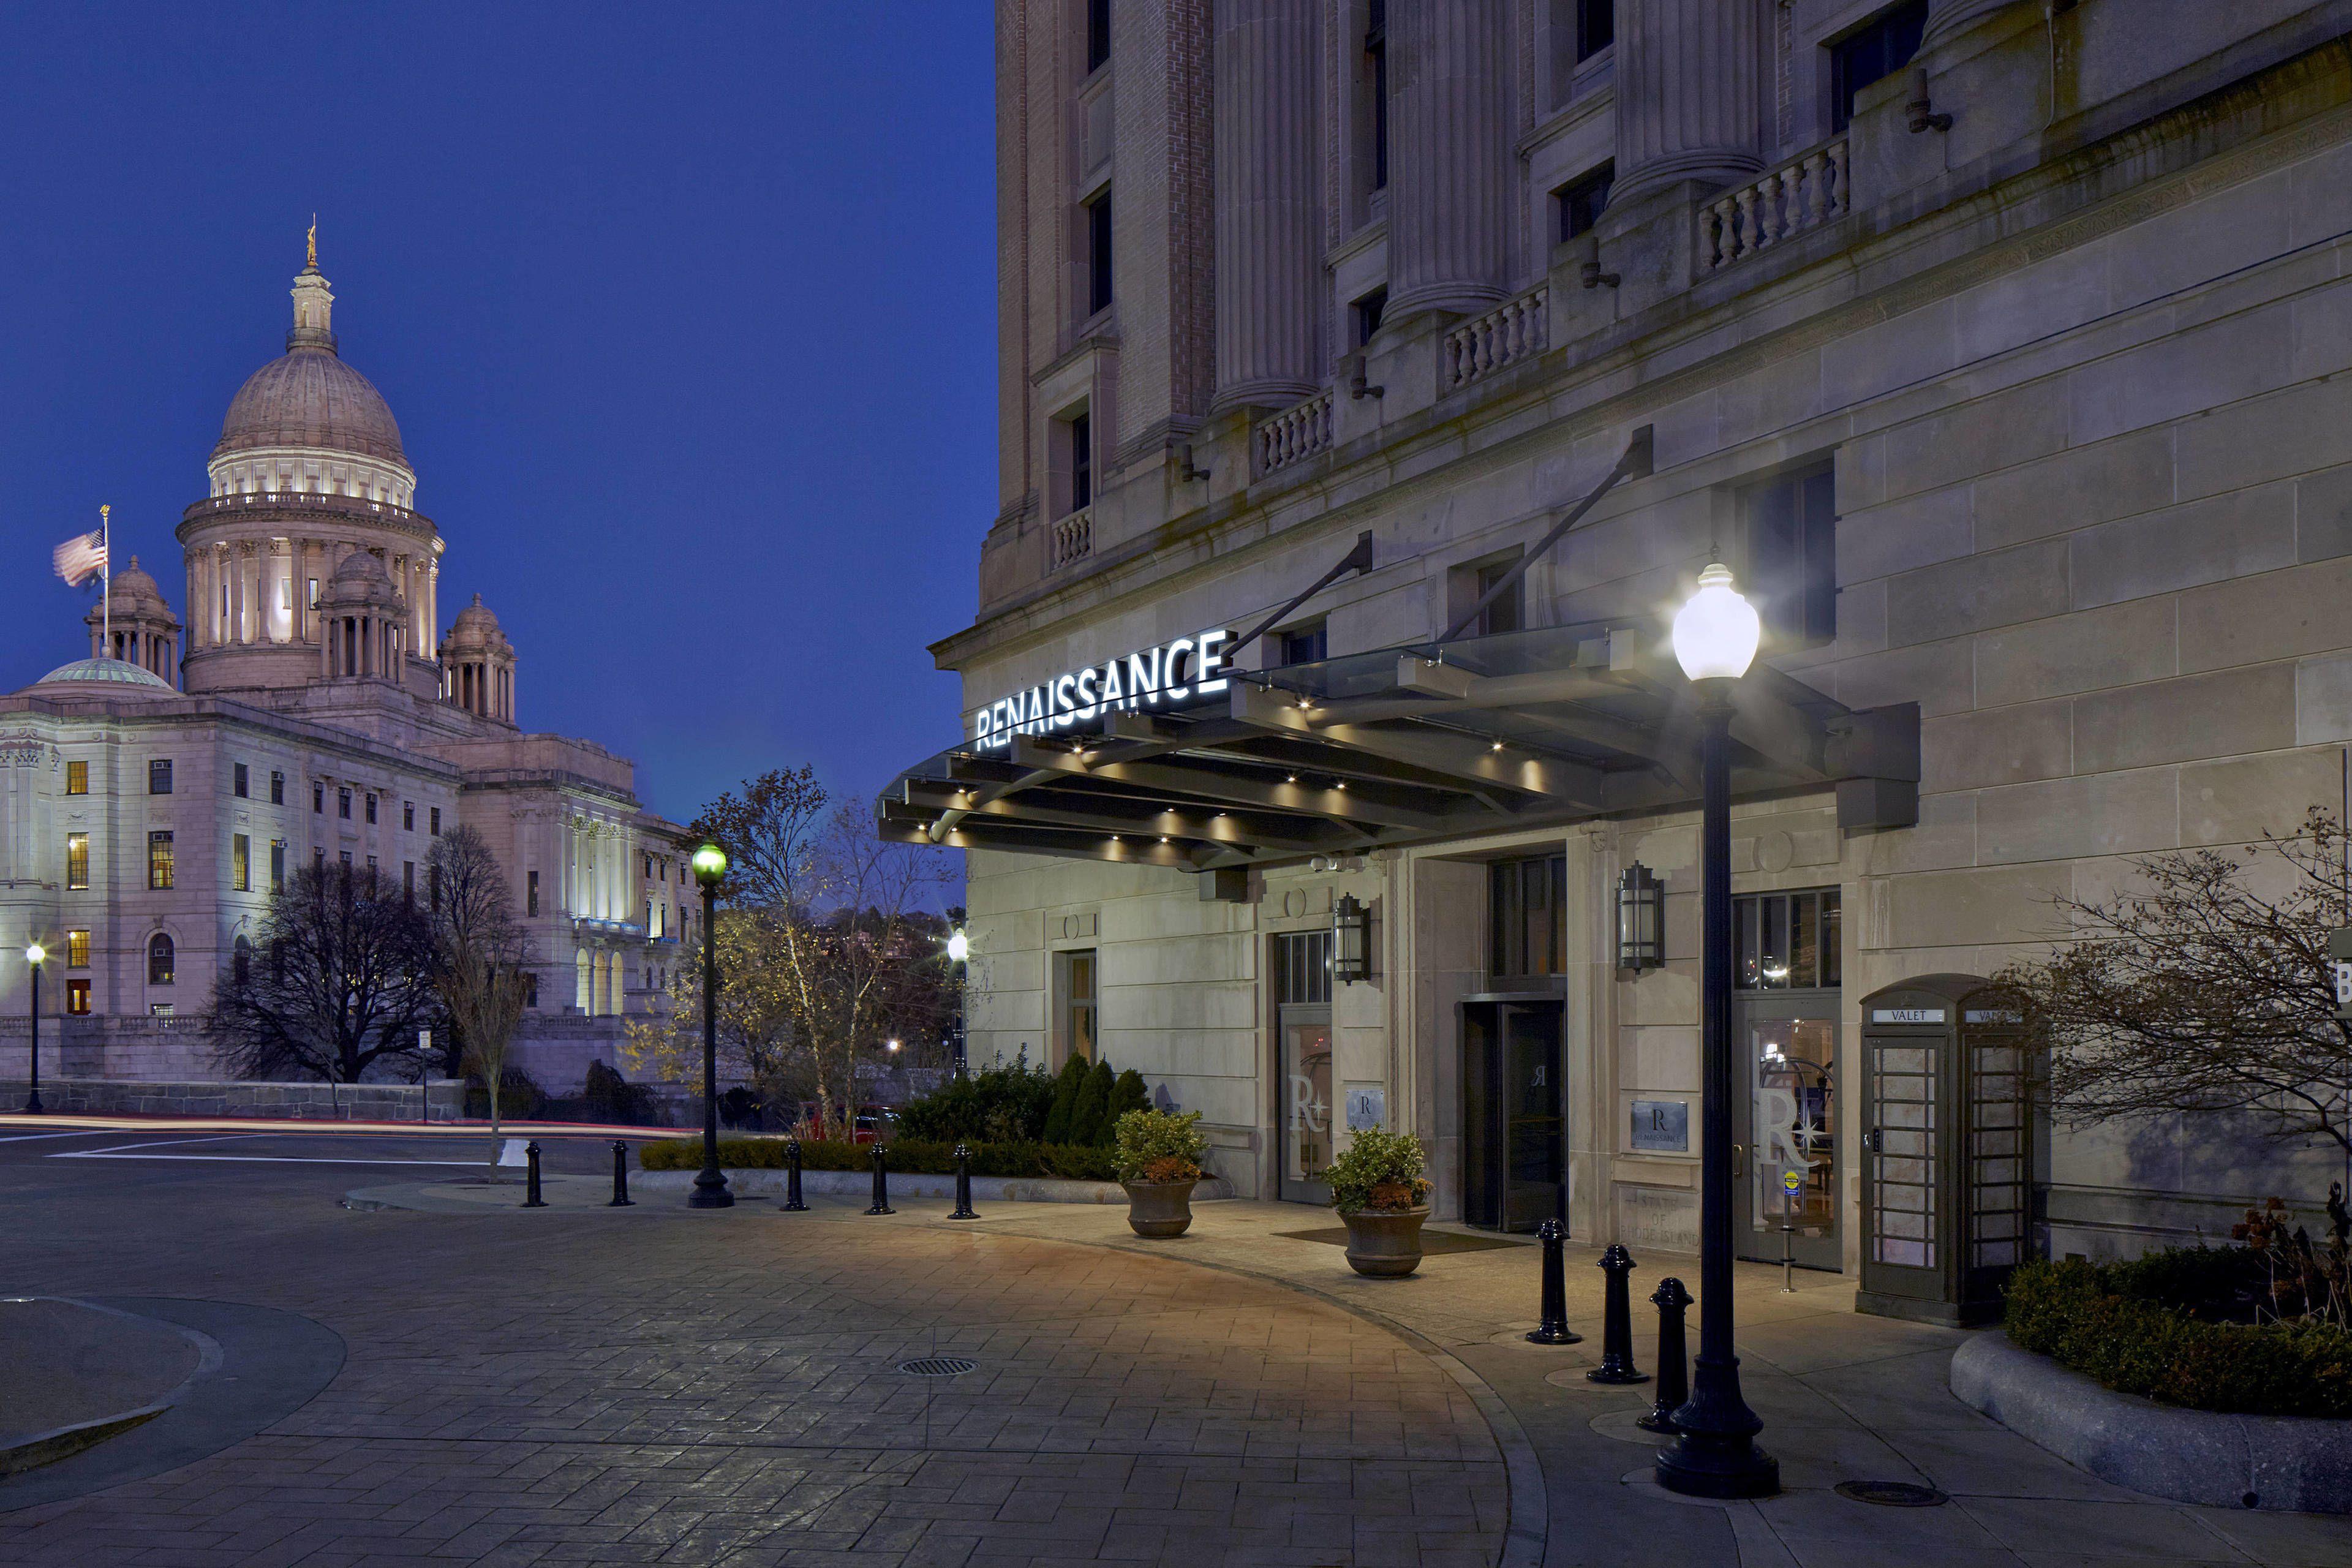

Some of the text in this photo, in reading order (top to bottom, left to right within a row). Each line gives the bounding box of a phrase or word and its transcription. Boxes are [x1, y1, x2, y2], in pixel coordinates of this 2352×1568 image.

[976, 630, 1227, 752] RENAISSANCE
[1891, 1011, 1926, 1020] VALET
[1289, 1075, 1325, 1133] R
[1361, 1096, 1371, 1114] R
[1653, 1109, 1667, 1131] R
[1754, 1088, 1820, 1167] R
[1642, 1195, 1677, 1212] STATE
[1652, 1213, 1666, 1226] OF
[1621, 1224, 1700, 1246] RHODE ISLAND
